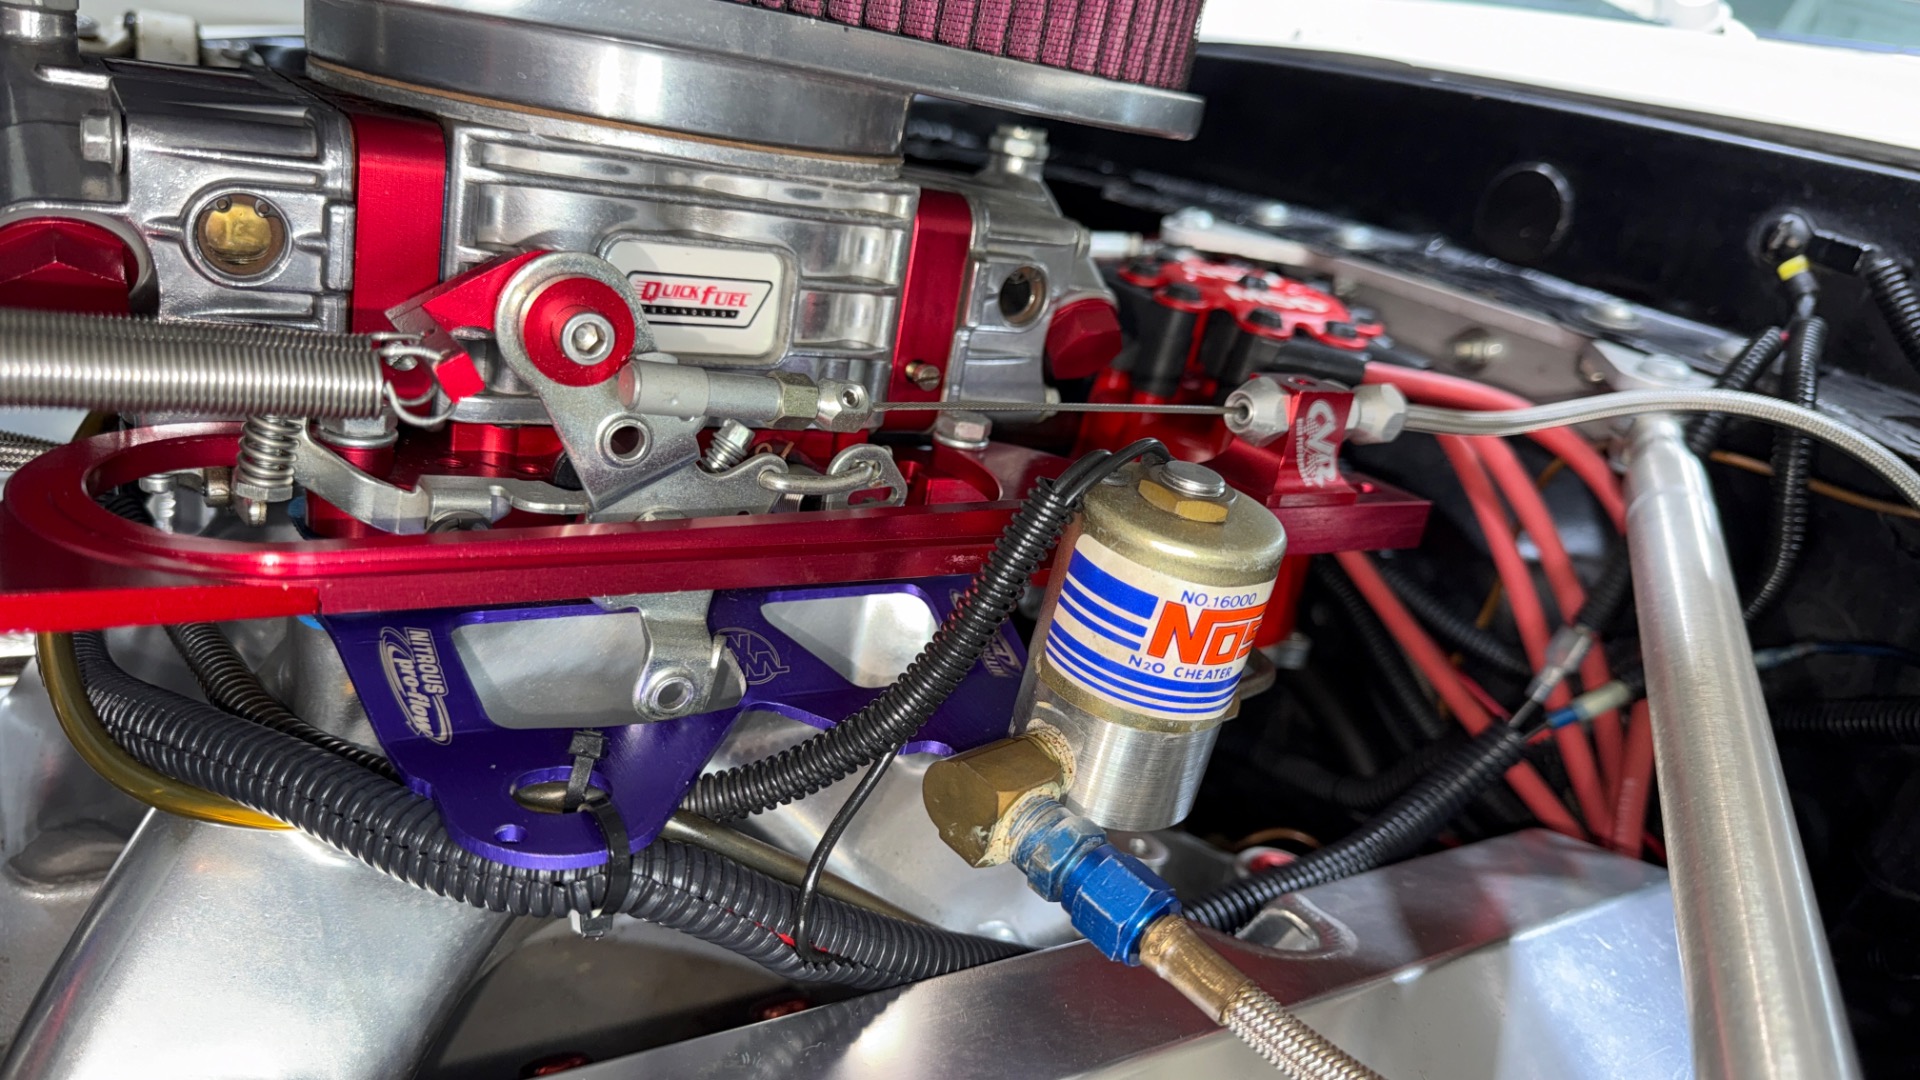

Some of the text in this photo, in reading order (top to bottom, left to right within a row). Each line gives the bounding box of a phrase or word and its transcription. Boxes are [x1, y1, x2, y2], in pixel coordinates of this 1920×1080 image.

[636, 281, 701, 304] QUICK
[1305, 399, 1337, 488] CVR
[408, 629, 446, 695] NITROUS
[1173, 667, 1233, 681] CHEATER
[392, 656, 434, 738] pro-flow
